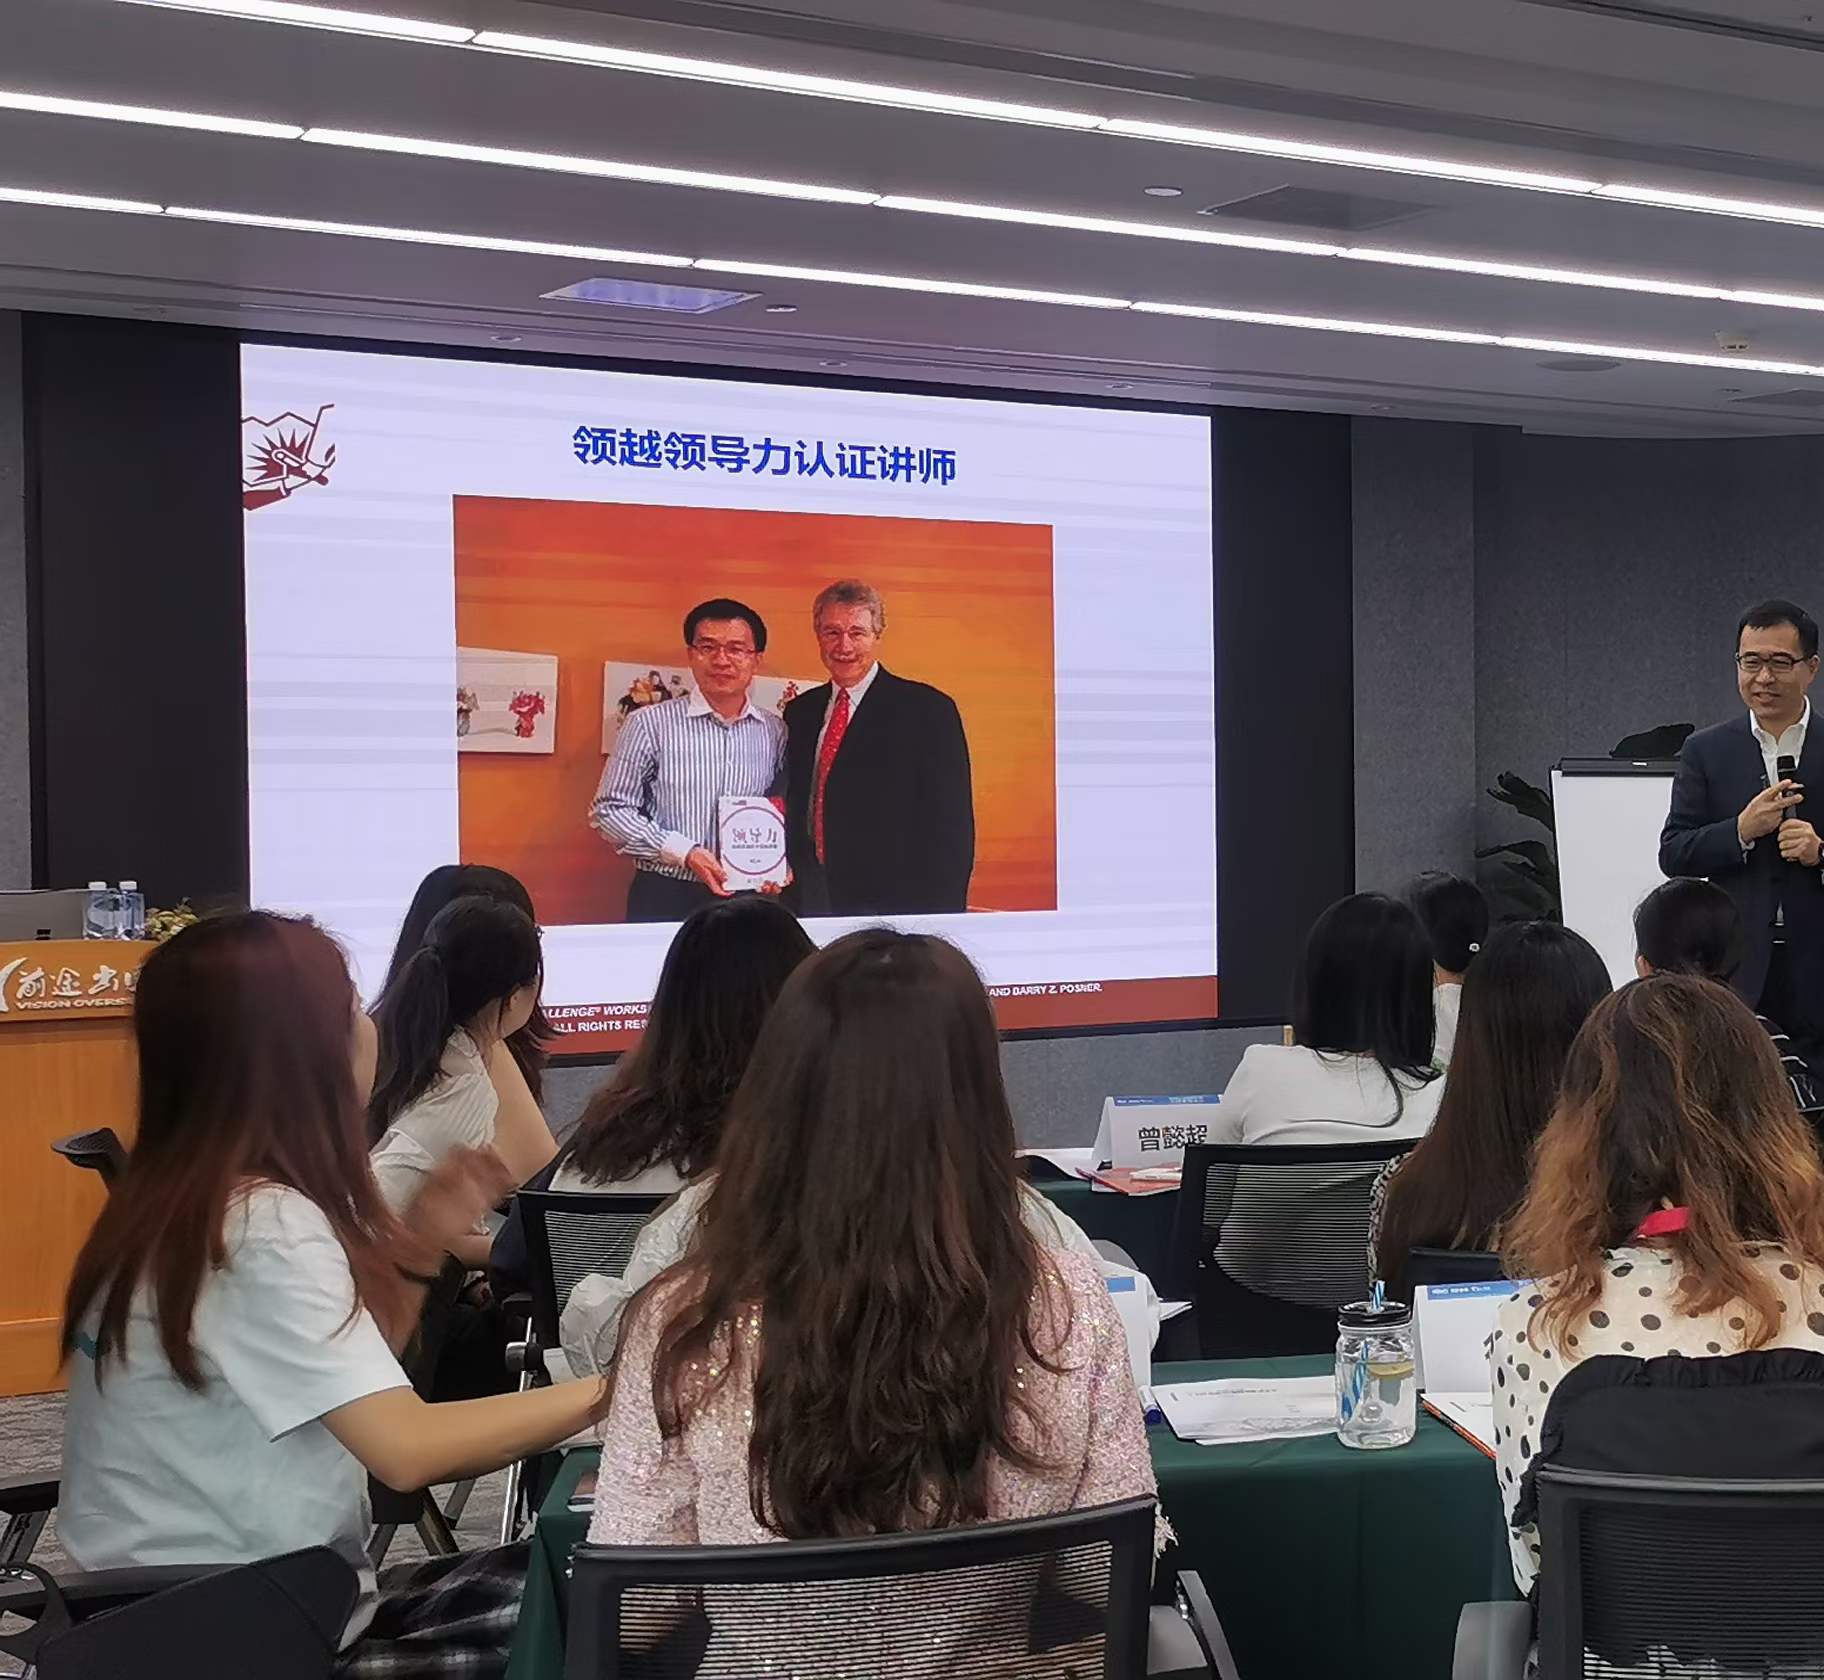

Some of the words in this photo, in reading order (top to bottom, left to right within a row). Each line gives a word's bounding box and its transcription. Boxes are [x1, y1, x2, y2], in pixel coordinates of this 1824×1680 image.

[573, 425, 957, 485] 领越领导力认证讲师
[16, 1000, 72, 1009] VISION
[577, 1019, 622, 1032] RIGHTS
